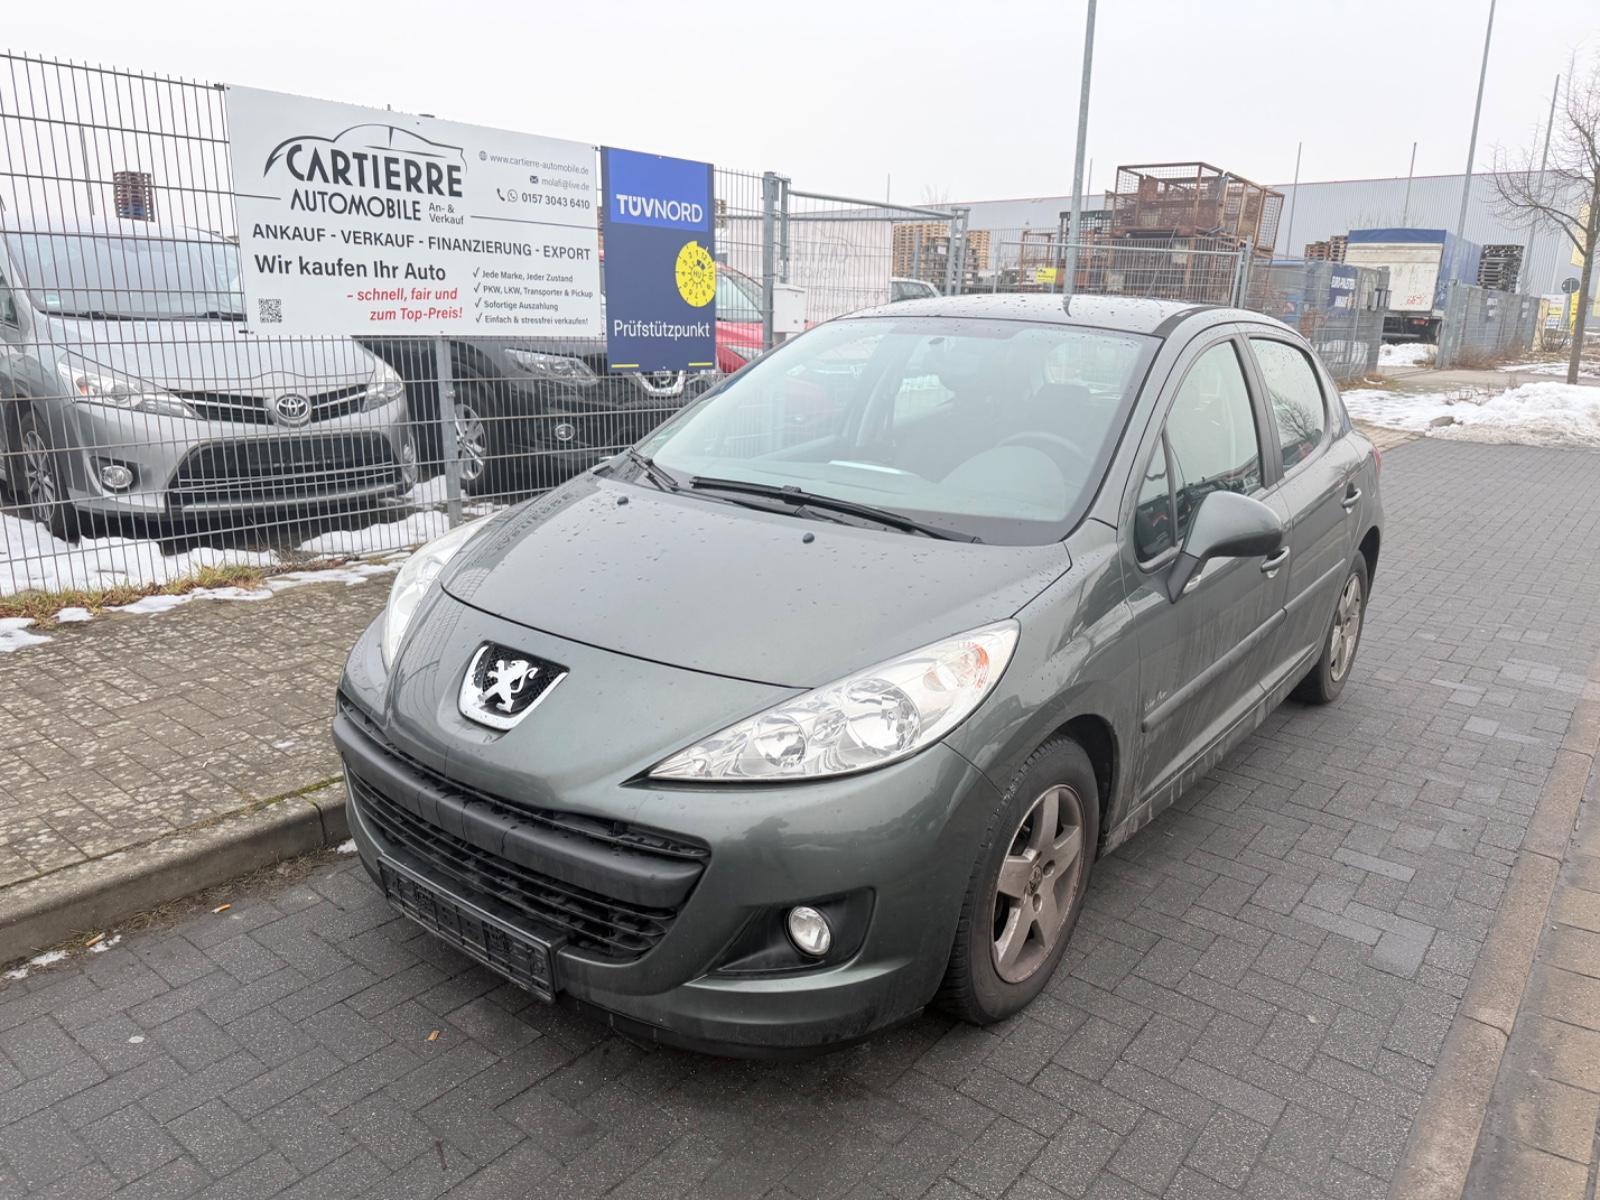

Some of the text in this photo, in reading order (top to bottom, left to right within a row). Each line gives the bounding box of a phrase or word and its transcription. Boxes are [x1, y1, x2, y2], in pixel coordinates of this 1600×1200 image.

[286, 144, 464, 198] CARTIERRE
[490, 153, 589, 176] www.cartierre-automobile.de
[290, 188, 421, 221] AUTOMOBILE
[429, 202, 455, 213] An- &
[522, 192, 590, 210] 0157 3043 6410
[429, 213, 464, 225] Verkauf
[252, 223, 326, 243] ANKAUF
[340, 229, 415, 248] VERKAUF
[428, 236, 532, 257] FINANZIERUNG
[543, 245, 591, 260] EXPORT
[254, 254, 446, 281] Wir kaufen Ihr Auto
[482, 270, 573, 283] Jede Marke, Jeder Zustand
[357, 287, 407, 302] schnell,
[410, 287, 432, 301] fair
[435, 287, 458, 300] und
[483, 285, 503, 294] PKW,
[504, 286, 522, 296] LKW,
[523, 287, 563, 298] Transporter
[571, 289, 593, 299] Pickup
[369, 306, 463, 323] zum Top-Preis!
[483, 300, 559, 312] Sofortige Auszahlung
[485, 315, 588, 326] Einfach & stressfrei verkaufen!
[614, 320, 710, 341] Prüfstützpunkt
